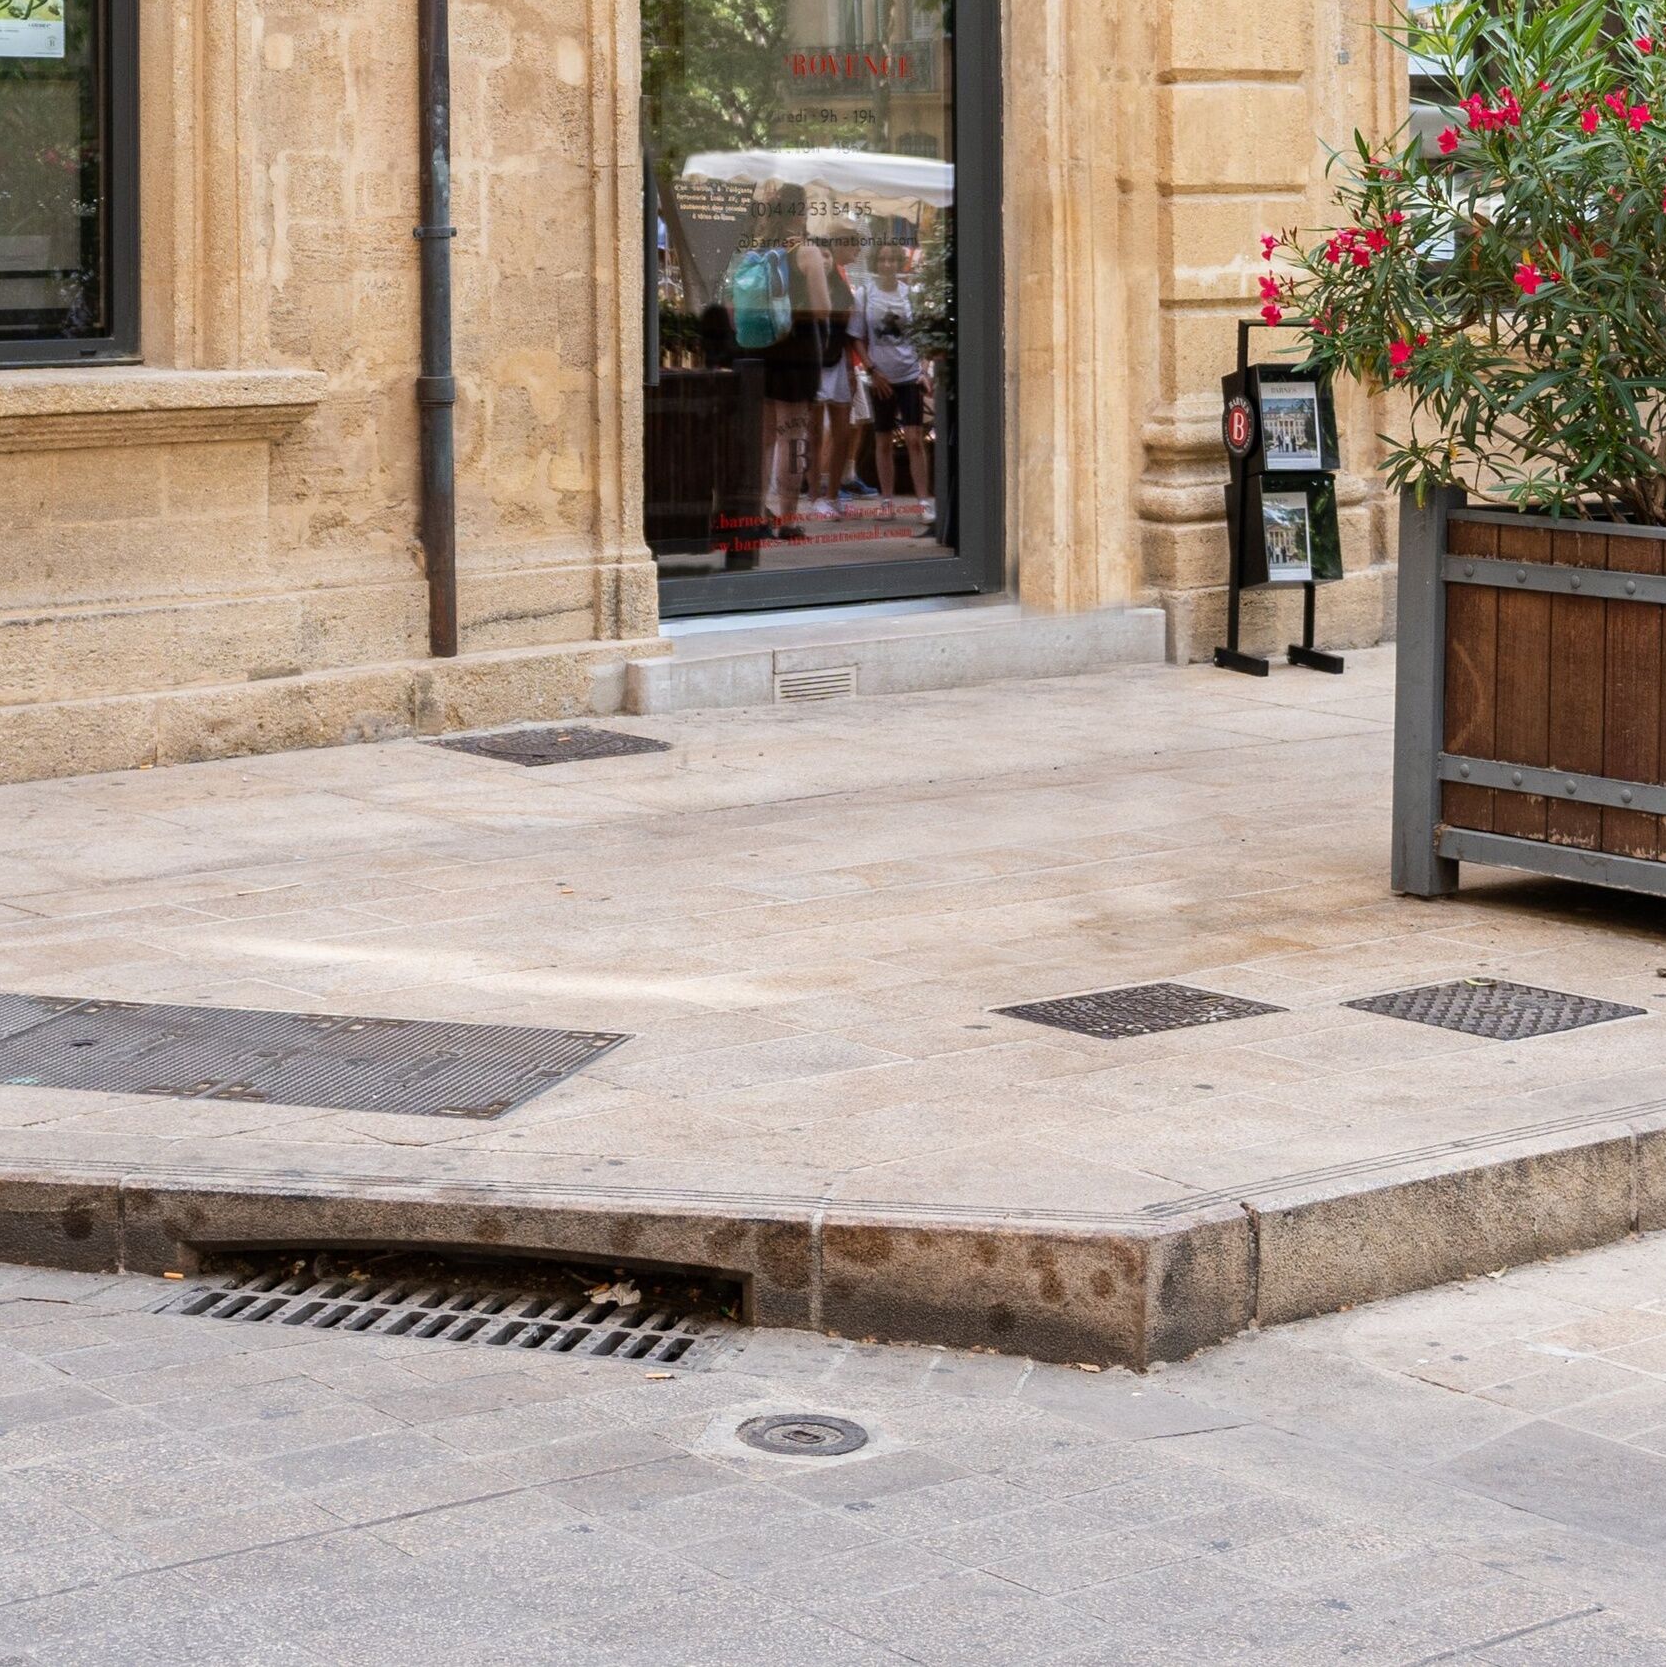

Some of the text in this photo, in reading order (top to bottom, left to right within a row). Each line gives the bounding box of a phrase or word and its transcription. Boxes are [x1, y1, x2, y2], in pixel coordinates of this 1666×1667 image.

[819, 109, 839, 124] 9h
[853, 109, 877, 124] 19h
[786, 201, 805, 216] 42
[810, 201, 828, 216] 53
[832, 201, 851, 216] 54
[854, 200, 873, 215] 55
[1234, 412, 1245, 441] B
[789, 439, 810, 475] B
